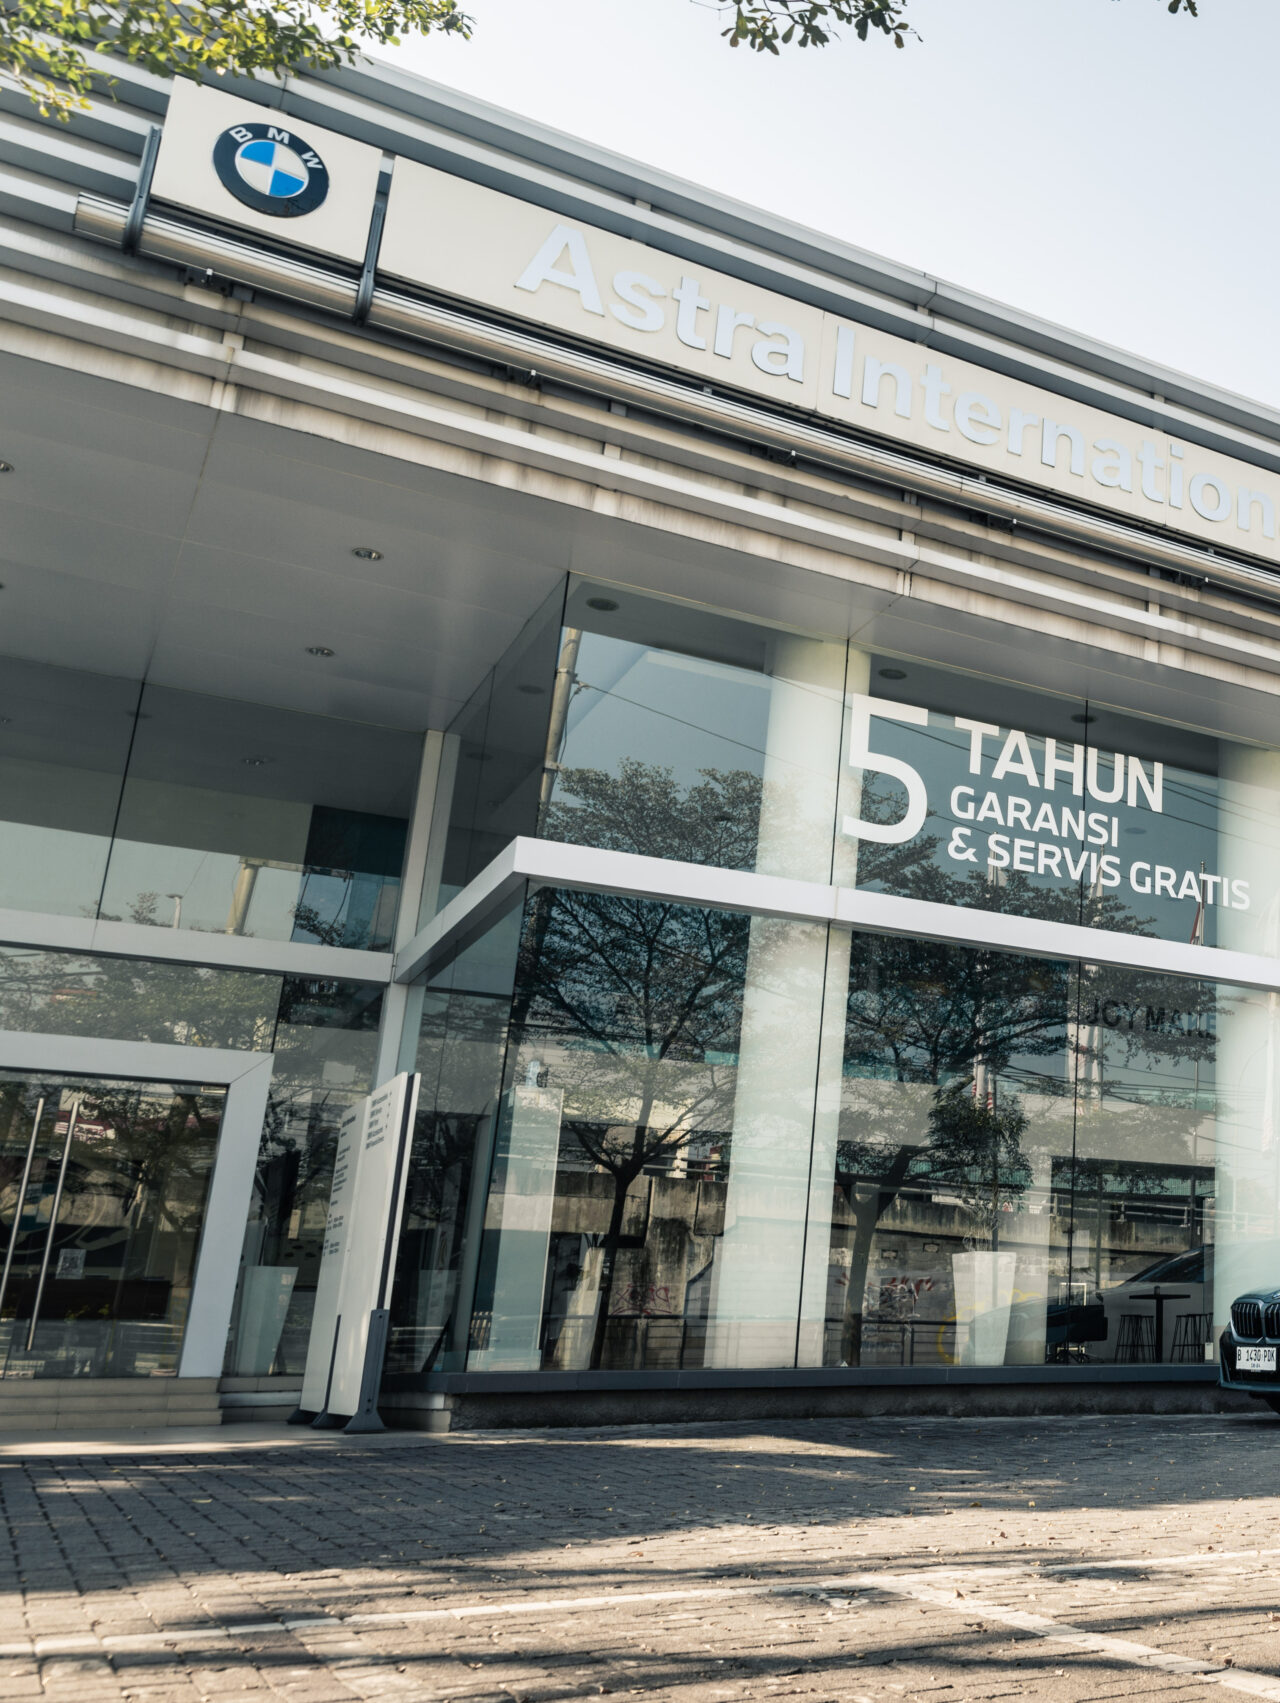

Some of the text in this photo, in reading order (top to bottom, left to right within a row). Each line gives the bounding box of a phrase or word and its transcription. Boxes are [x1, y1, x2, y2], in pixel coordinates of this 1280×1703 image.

[228, 126, 323, 169] BMW
[513, 223, 804, 384] Astra
[842, 693, 1164, 845] 5 TAHUN
[950, 785, 1119, 848] GARANSI
[947, 826, 1251, 911] & SERVIS GRATIS
[1237, 1349, 1242, 1361] B
[1264, 1350, 1275, 1362] PDK
